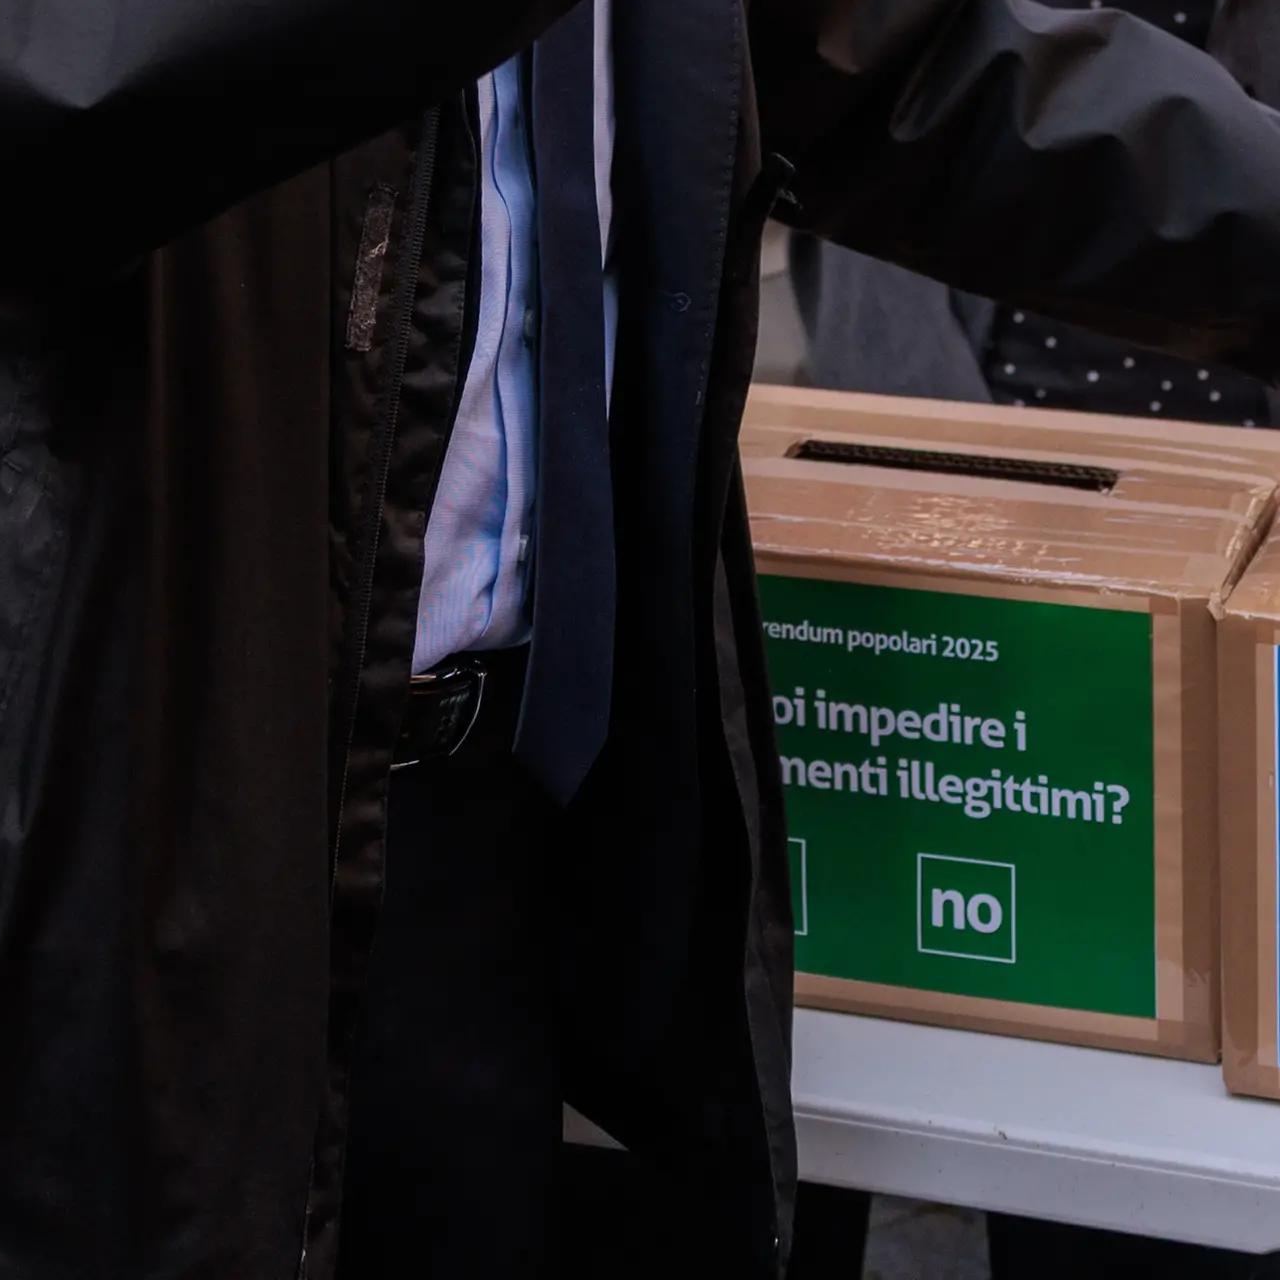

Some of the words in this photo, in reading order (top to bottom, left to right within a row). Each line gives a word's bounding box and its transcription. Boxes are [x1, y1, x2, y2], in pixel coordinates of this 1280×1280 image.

[762, 619, 843, 646] rendum
[847, 630, 938, 656] popolari
[941, 636, 1000, 663] 2025
[773, 686, 806, 728] oi
[814, 688, 1007, 748] impedire
[1013, 710, 1028, 752] i
[780, 755, 888, 796] menti
[896, 756, 1131, 825] illegittimi?
[931, 887, 1004, 935] no
